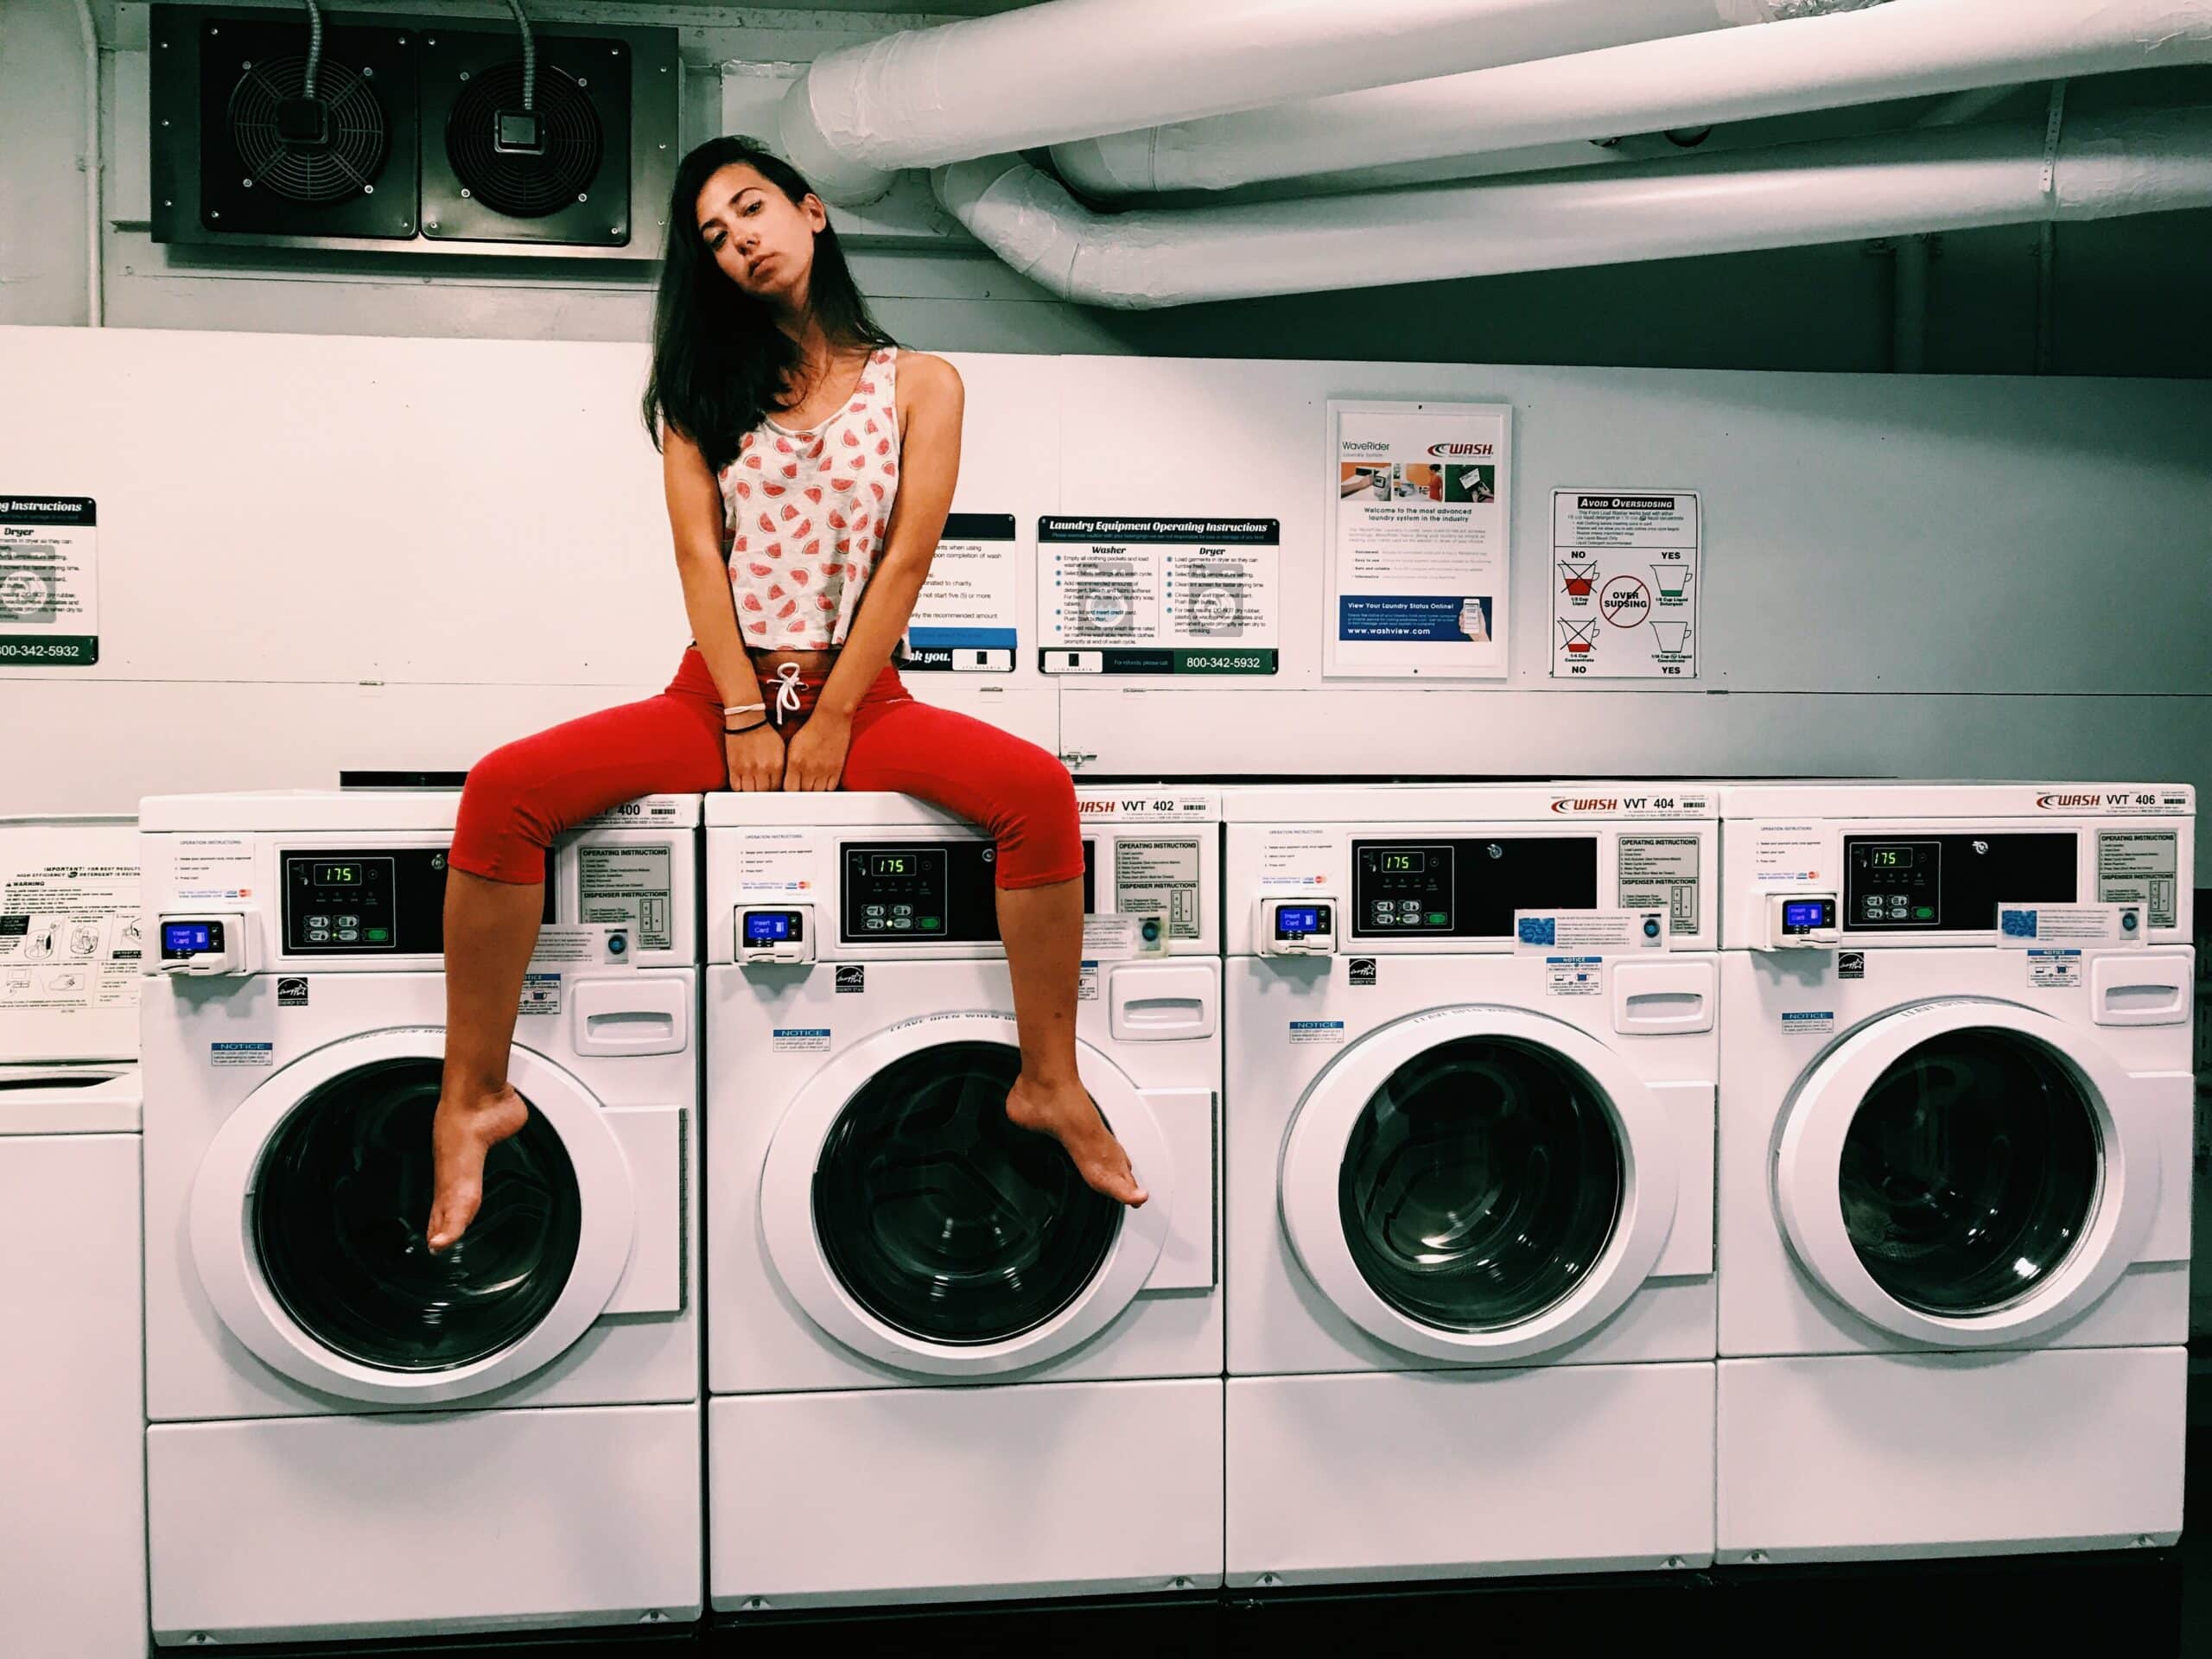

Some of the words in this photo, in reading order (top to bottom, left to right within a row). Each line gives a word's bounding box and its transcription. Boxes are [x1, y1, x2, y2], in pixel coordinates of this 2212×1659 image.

[1342, 442, 1389, 451] WaveRider
[1449, 443, 1493, 454] WASH
[11, 501, 82, 512] Instructions
[1580, 499, 1609, 507] AVOID
[1612, 499, 1673, 508] OVERSUDSING
[4, 528, 34, 537] Dryer
[1050, 521, 1094, 532] Laundry
[1096, 521, 1151, 532] Equipment
[1153, 522, 1205, 533] Operating
[1206, 523, 1268, 532] Instructions
[0, 645, 79, 657] 00-342-5932
[924, 652, 950, 663] you.
[1186, 658, 1260, 668] 800-342-5932
[1573, 799, 1617, 810] WASH
[1624, 798, 1647, 808] VVT
[1654, 798, 1674, 808] 404
[2058, 795, 2101, 805] WASH
[2107, 795, 2129, 804] VVT
[2136, 795, 2156, 804] 406
[618, 804, 640, 815] 400
[1122, 802, 1146, 810] VVT
[1153, 801, 1173, 810] 402
[1387, 856, 1409, 869] 175
[1874, 852, 1896, 865] 175
[880, 860, 904, 873] 175
[327, 868, 351, 881] 175
